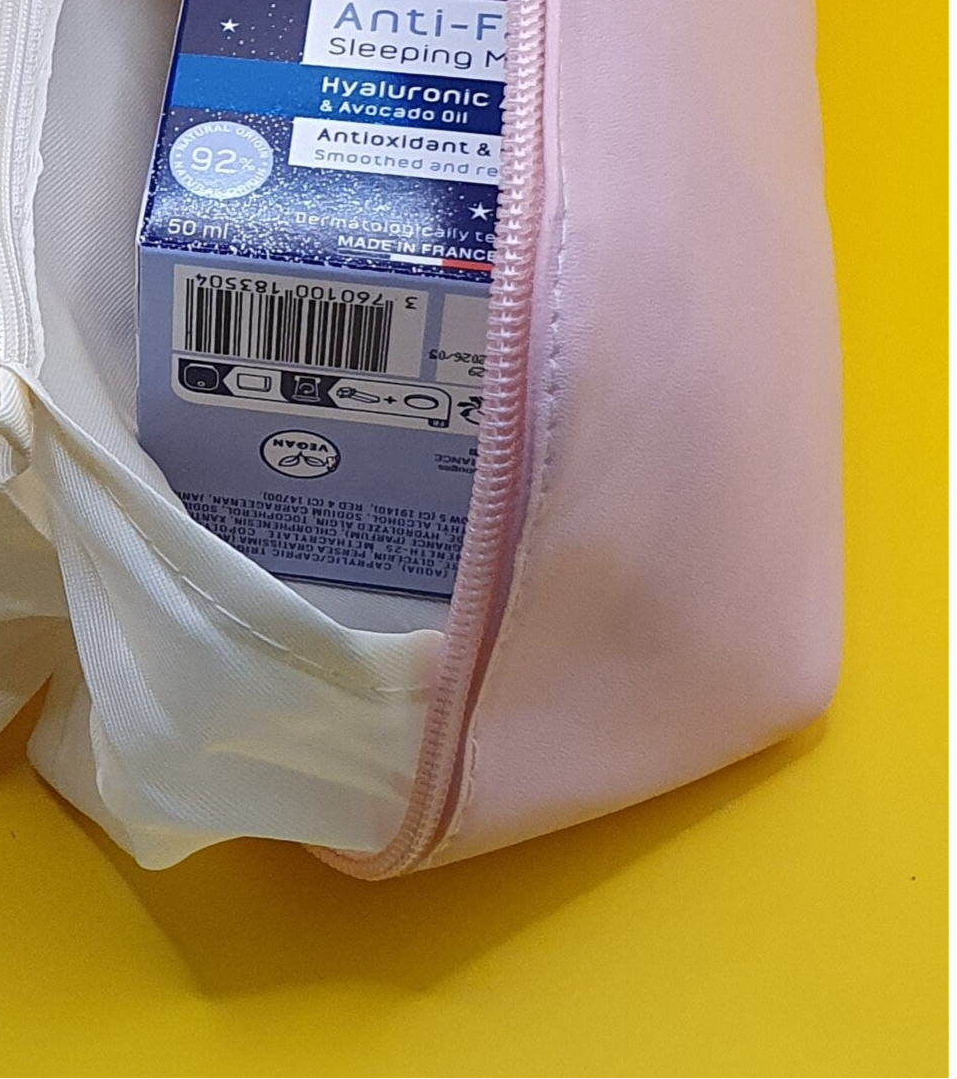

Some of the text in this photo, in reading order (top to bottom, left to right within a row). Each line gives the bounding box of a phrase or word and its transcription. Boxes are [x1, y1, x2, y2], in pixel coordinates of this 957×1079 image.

[333, 1, 508, 42] Anti-F
[328, 36, 473, 70] Sleeping
[321, 75, 490, 108] Hyaluronic
[319, 99, 333, 113] &
[338, 100, 436, 121] Avocado
[176, 124, 232, 151] NATURAL
[316, 127, 492, 157] Antioxidant &
[190, 146, 256, 174] 92%
[314, 148, 423, 171] Smoothed
[429, 160, 469, 175] and
[167, 218, 230, 240] 50 ml
[295, 210, 470, 242] Dermatologically
[337, 234, 392, 252] MADE
[397, 241, 416, 254] IN
[194, 272, 419, 310] 3 760100 183504
[272, 437, 330, 453] VEGAN
[311, 507, 363, 522] SODIUM
[338, 501, 363, 512] RED
